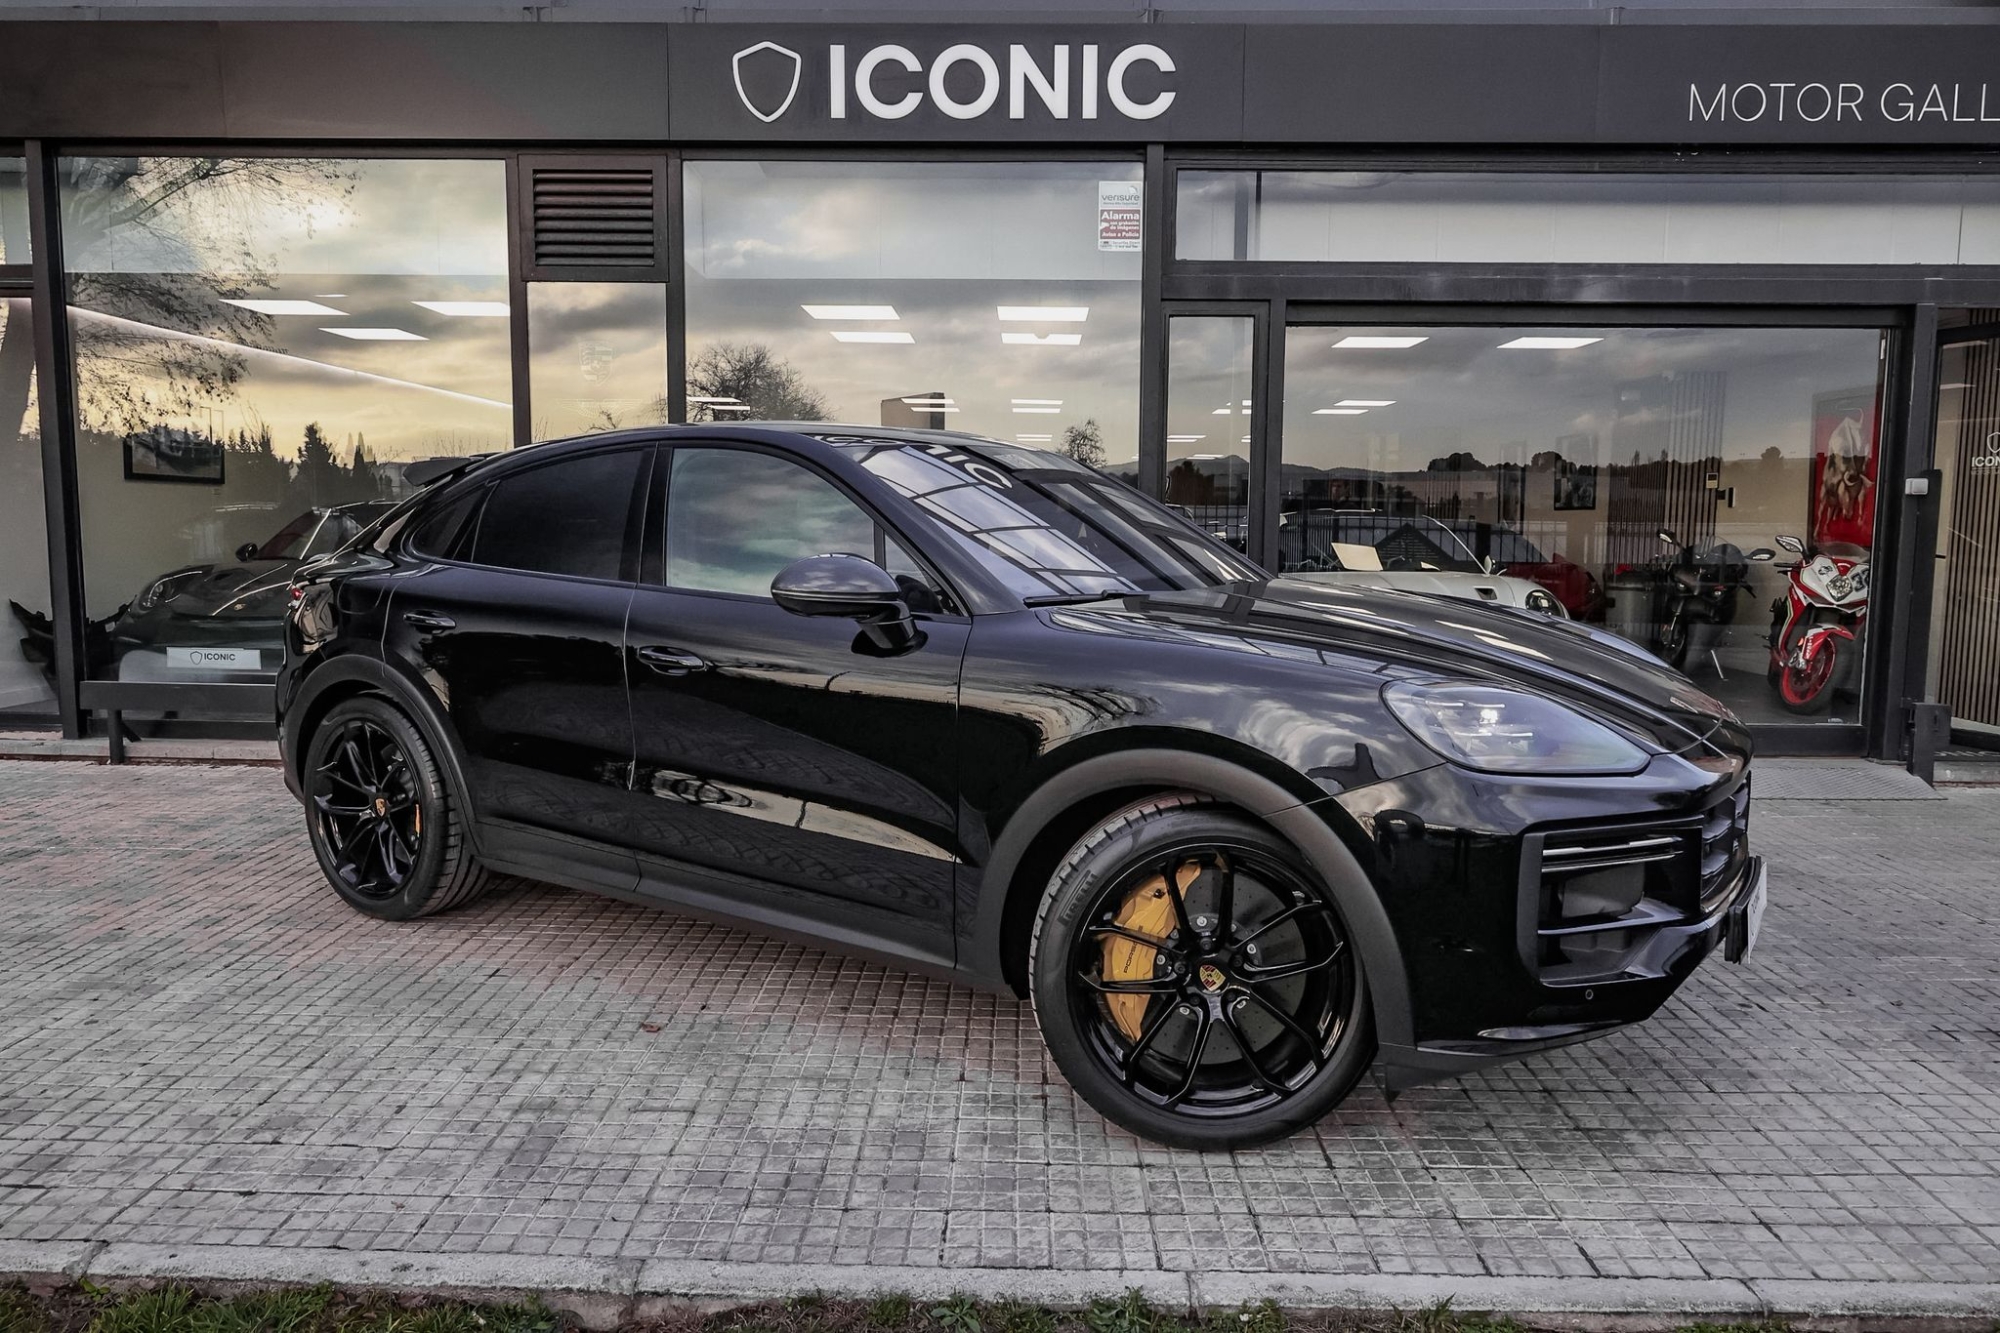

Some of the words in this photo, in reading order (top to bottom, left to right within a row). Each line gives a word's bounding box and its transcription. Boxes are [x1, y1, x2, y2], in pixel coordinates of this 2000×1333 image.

[830, 44, 1177, 120] ICONIC
[1689, 83, 1864, 122] MOTOR
[1880, 83, 2000, 122] GALL
[1101, 194, 1140, 202] verisure
[1101, 211, 1140, 220] Alarma
[204, 652, 236, 661] ICONIC
[1058, 868, 1099, 927] PIRELLI
[1123, 925, 1144, 974] PORSE
